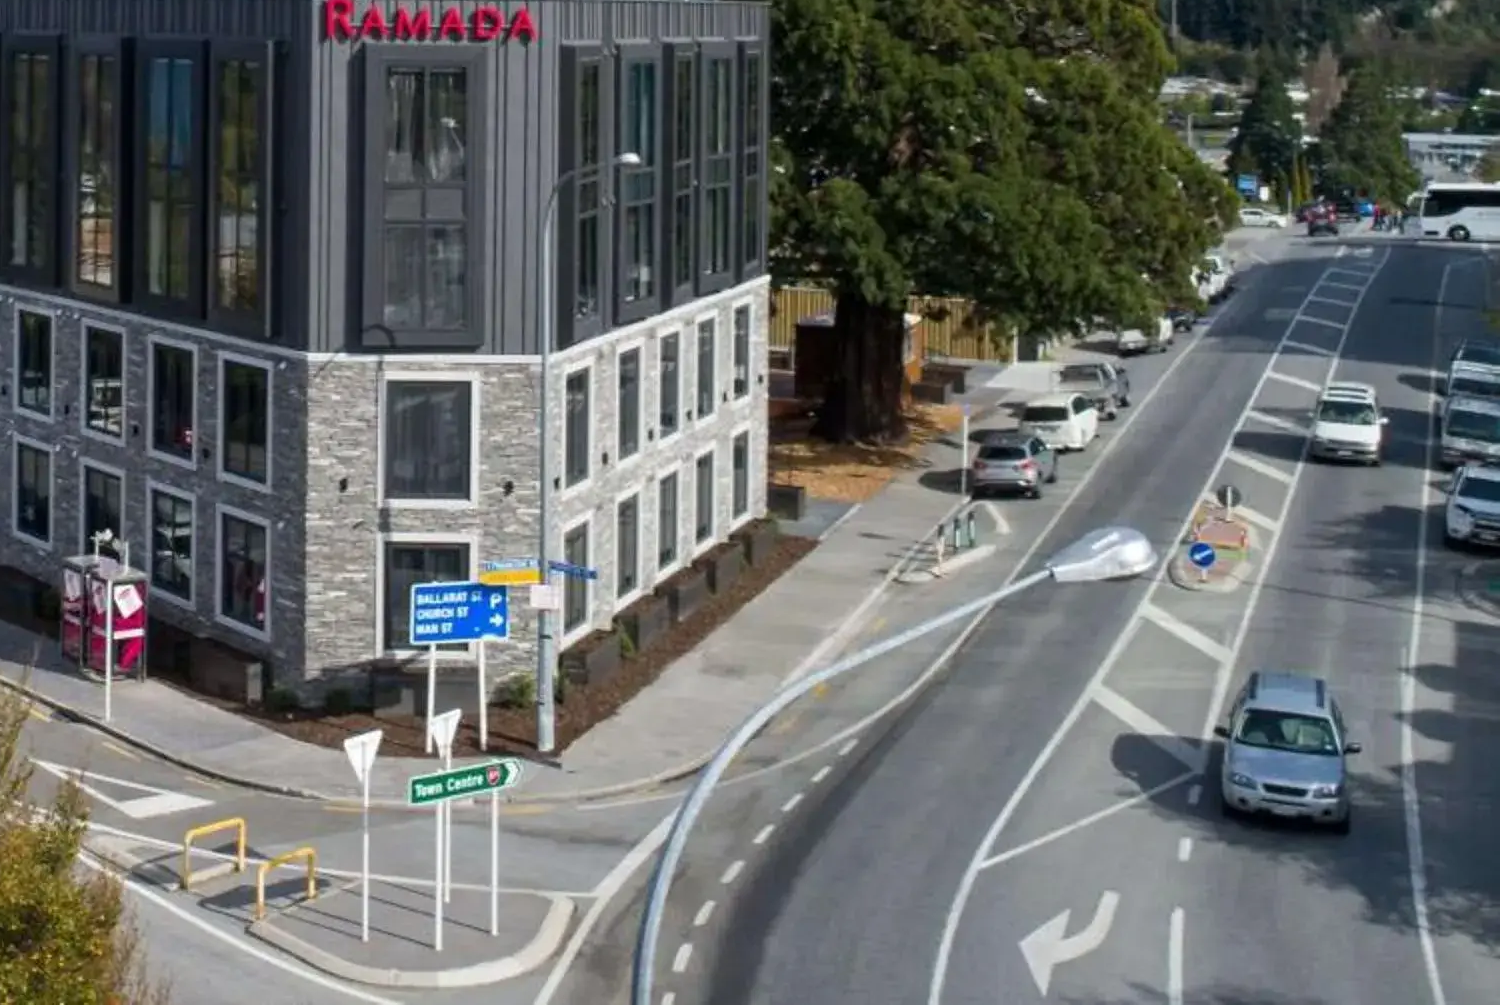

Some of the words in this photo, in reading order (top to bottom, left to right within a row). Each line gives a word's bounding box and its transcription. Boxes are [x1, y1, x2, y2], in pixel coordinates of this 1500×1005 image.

[416, 608, 454, 621] CHURCH
[457, 606, 469, 618] ST
[441, 622, 453, 634] ST
[415, 783, 443, 798] Town
[446, 774, 484, 792] Centre
